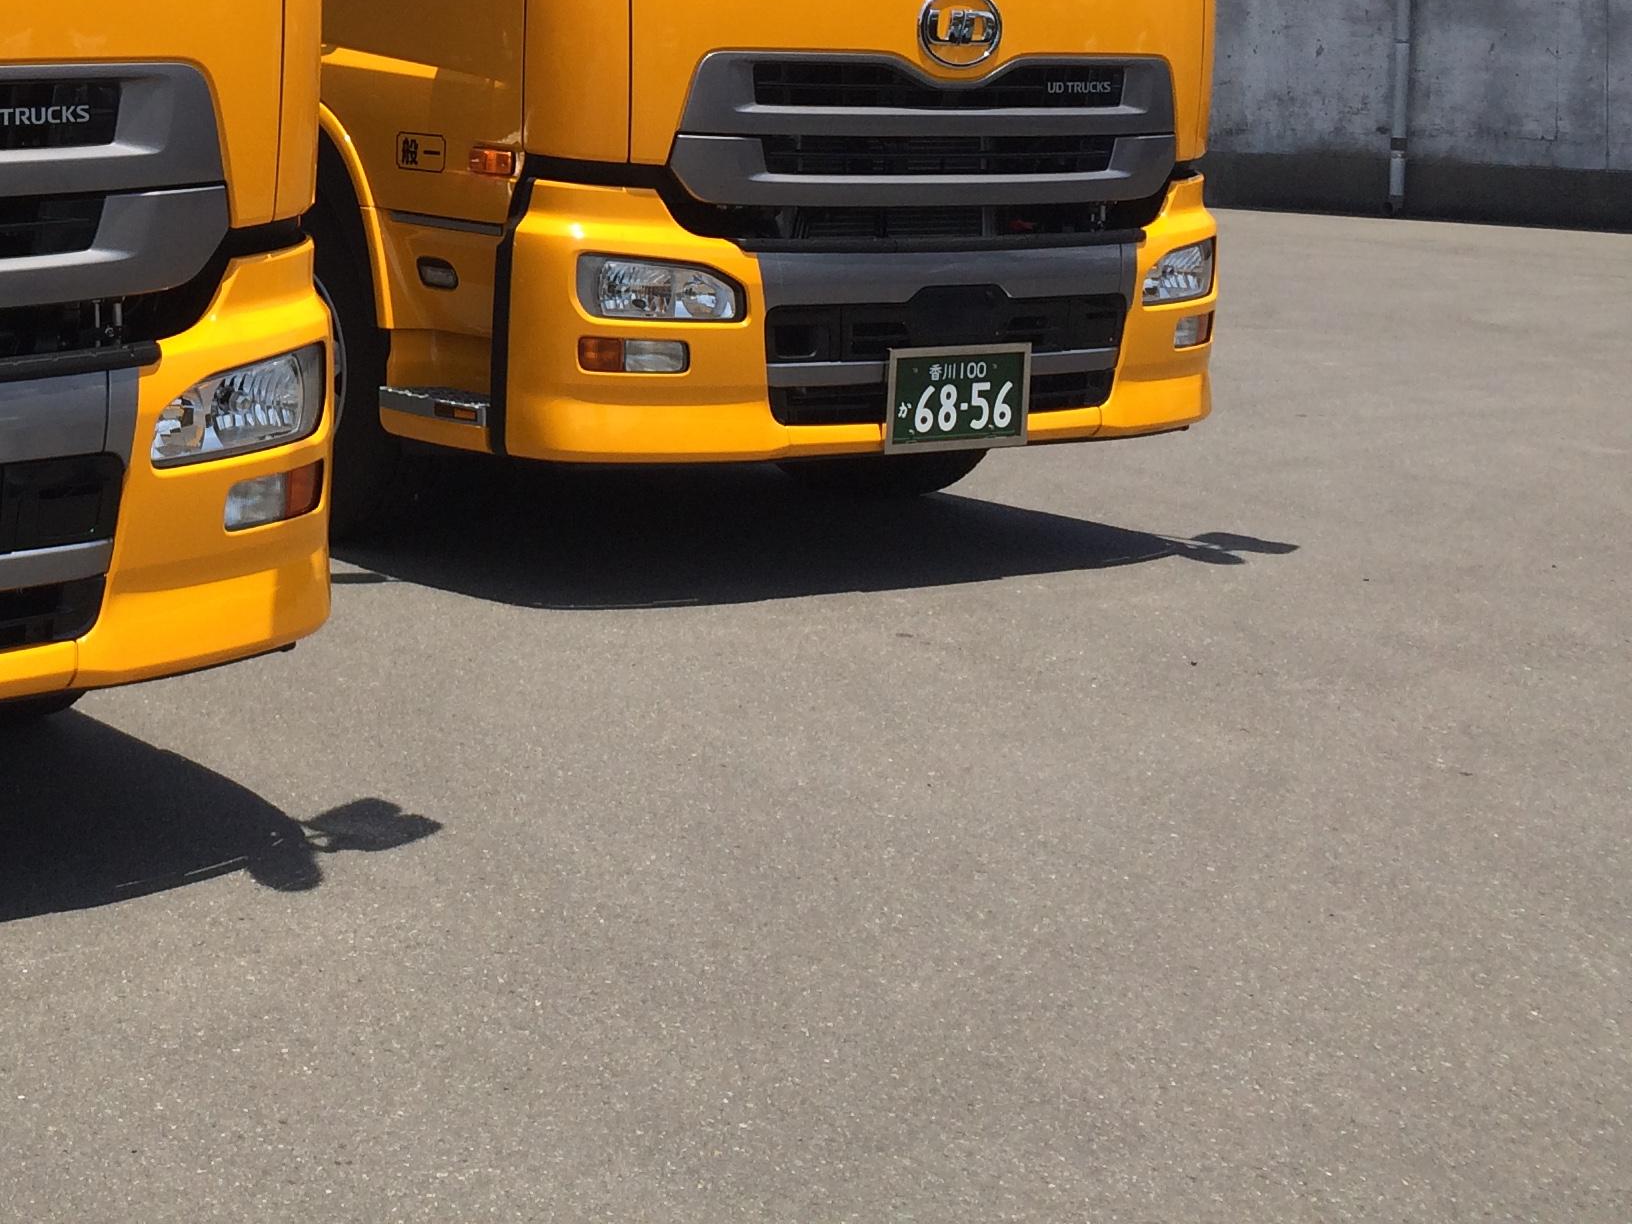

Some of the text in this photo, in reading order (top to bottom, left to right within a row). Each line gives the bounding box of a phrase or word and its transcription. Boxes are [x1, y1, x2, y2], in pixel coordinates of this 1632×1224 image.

[1047, 81, 1112, 94] UD TRUCKS
[914, 380, 1013, 433] 68-56
